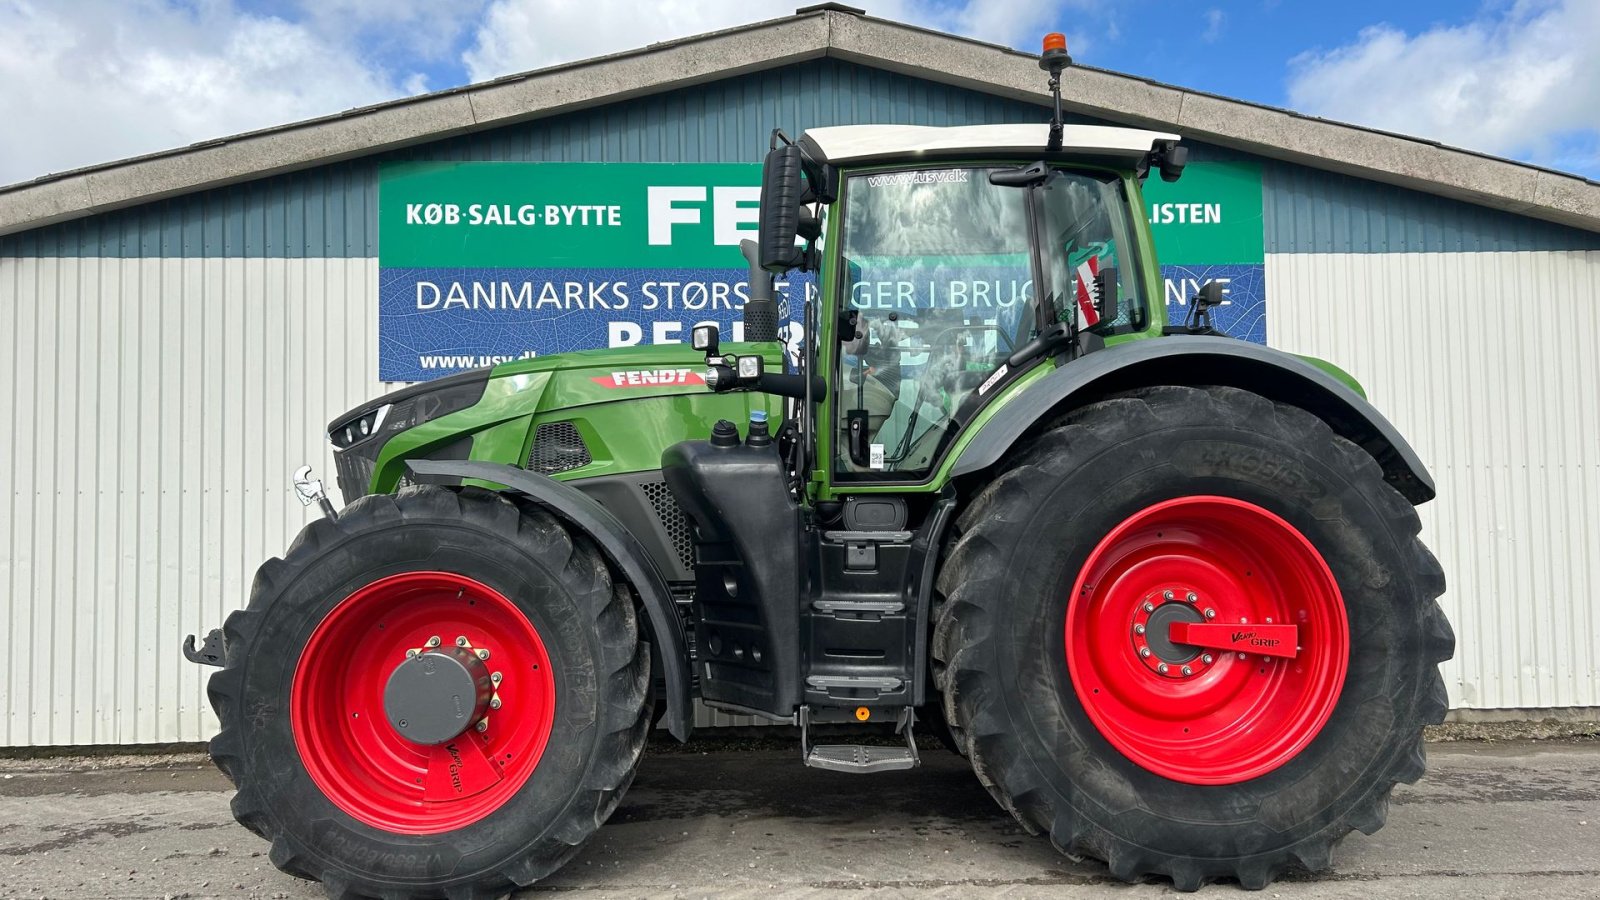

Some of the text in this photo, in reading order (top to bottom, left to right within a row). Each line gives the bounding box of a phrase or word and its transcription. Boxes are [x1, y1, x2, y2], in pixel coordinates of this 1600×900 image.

[868, 169, 968, 187] www.usv.dk
[1148, 203, 1221, 224] ISTEN
[416, 281, 630, 310] DANMARKS
[641, 280, 791, 311] STØRSE
[611, 368, 692, 386] FENDT
[1250, 638, 1280, 647] GRIP
[449, 763, 463, 793] GRIP
